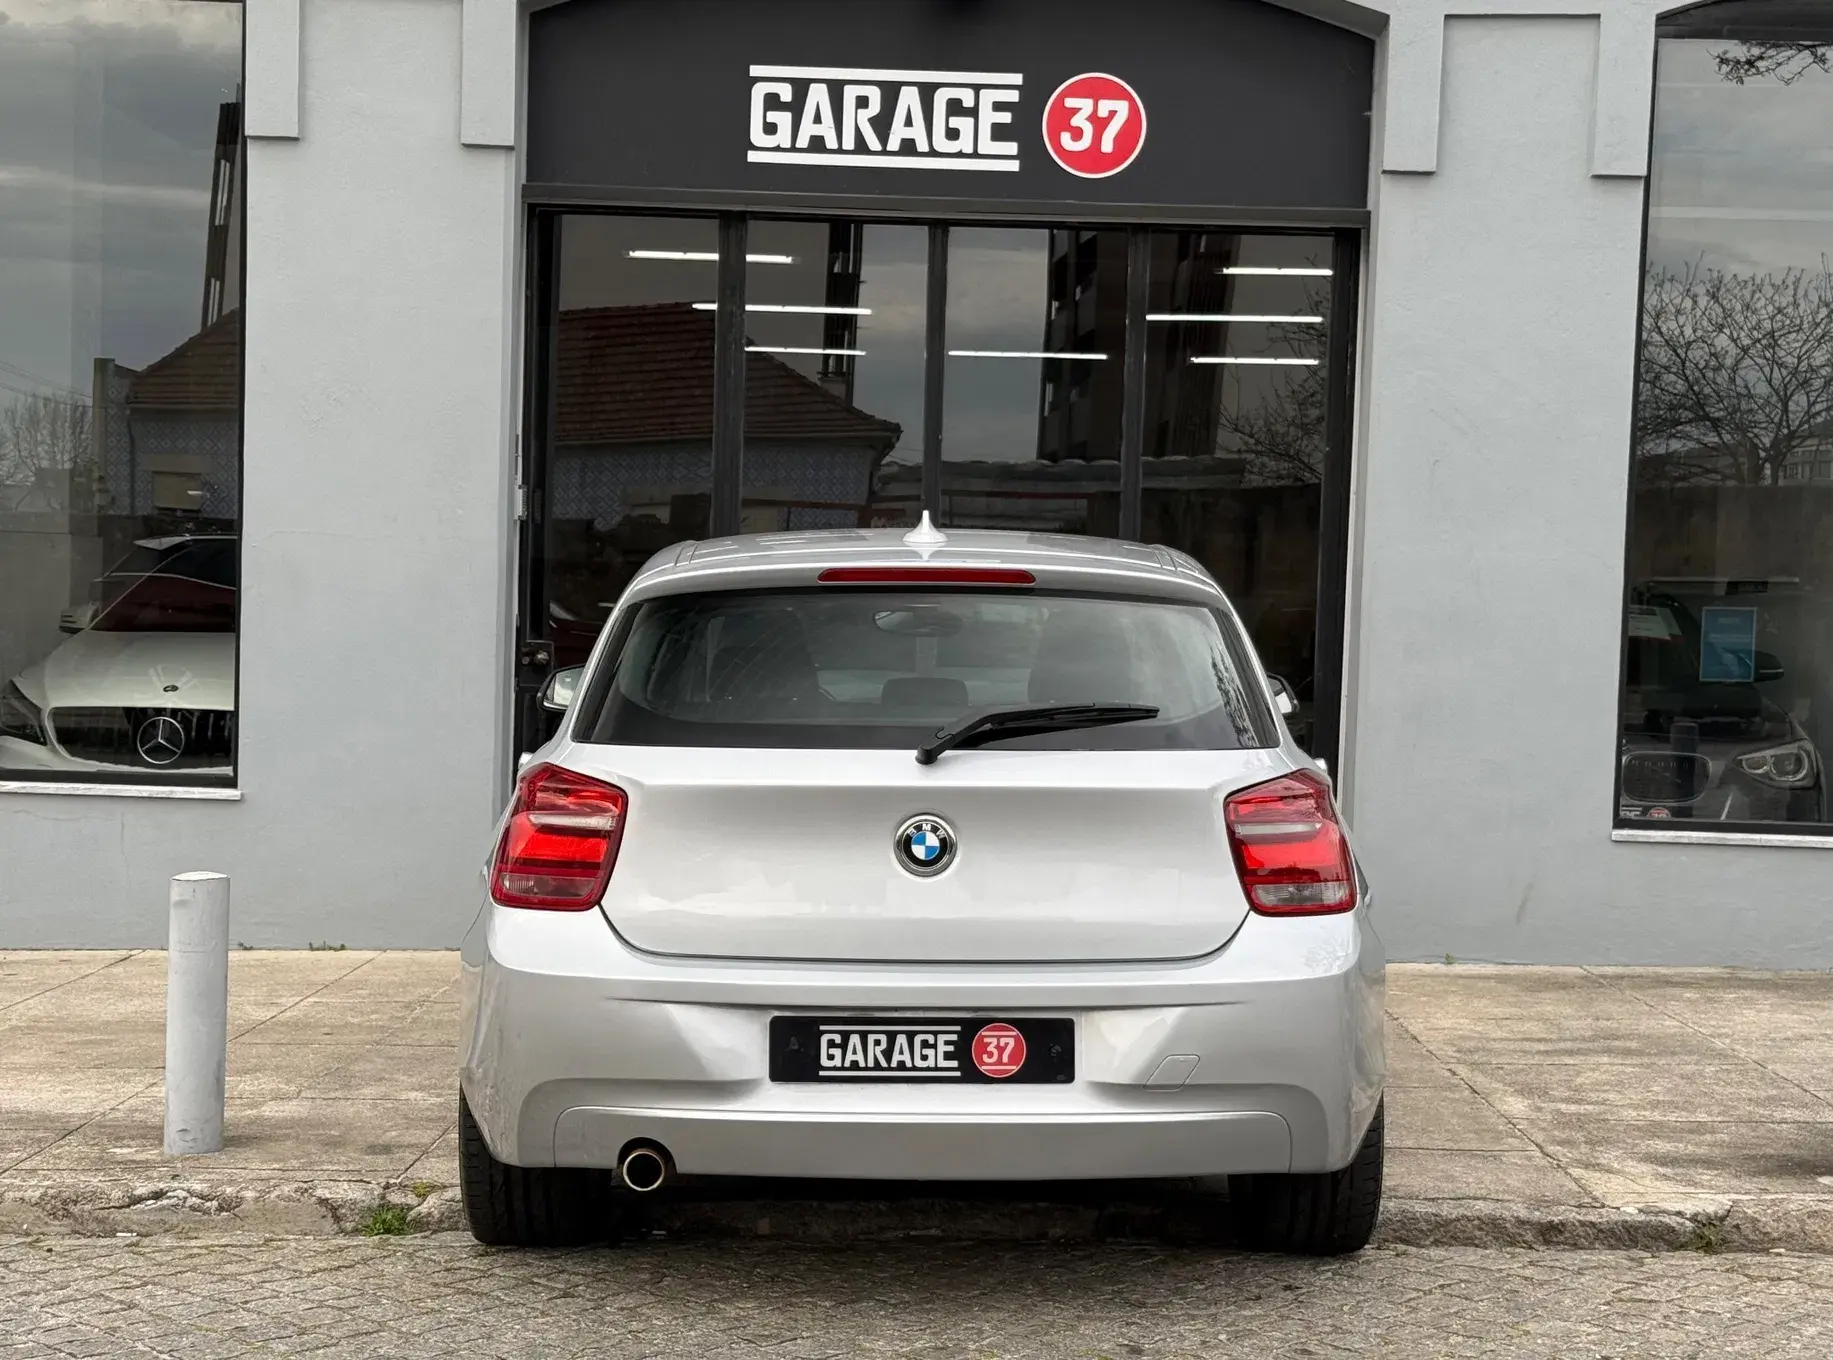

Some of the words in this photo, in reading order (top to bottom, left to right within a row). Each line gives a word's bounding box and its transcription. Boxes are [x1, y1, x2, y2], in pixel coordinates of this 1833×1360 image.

[750, 82, 1019, 155] GARAGE
[1059, 97, 1130, 153] 37
[907, 823, 946, 838] BMW
[820, 1033, 958, 1067] GARAGE
[982, 1037, 1015, 1063] 37
